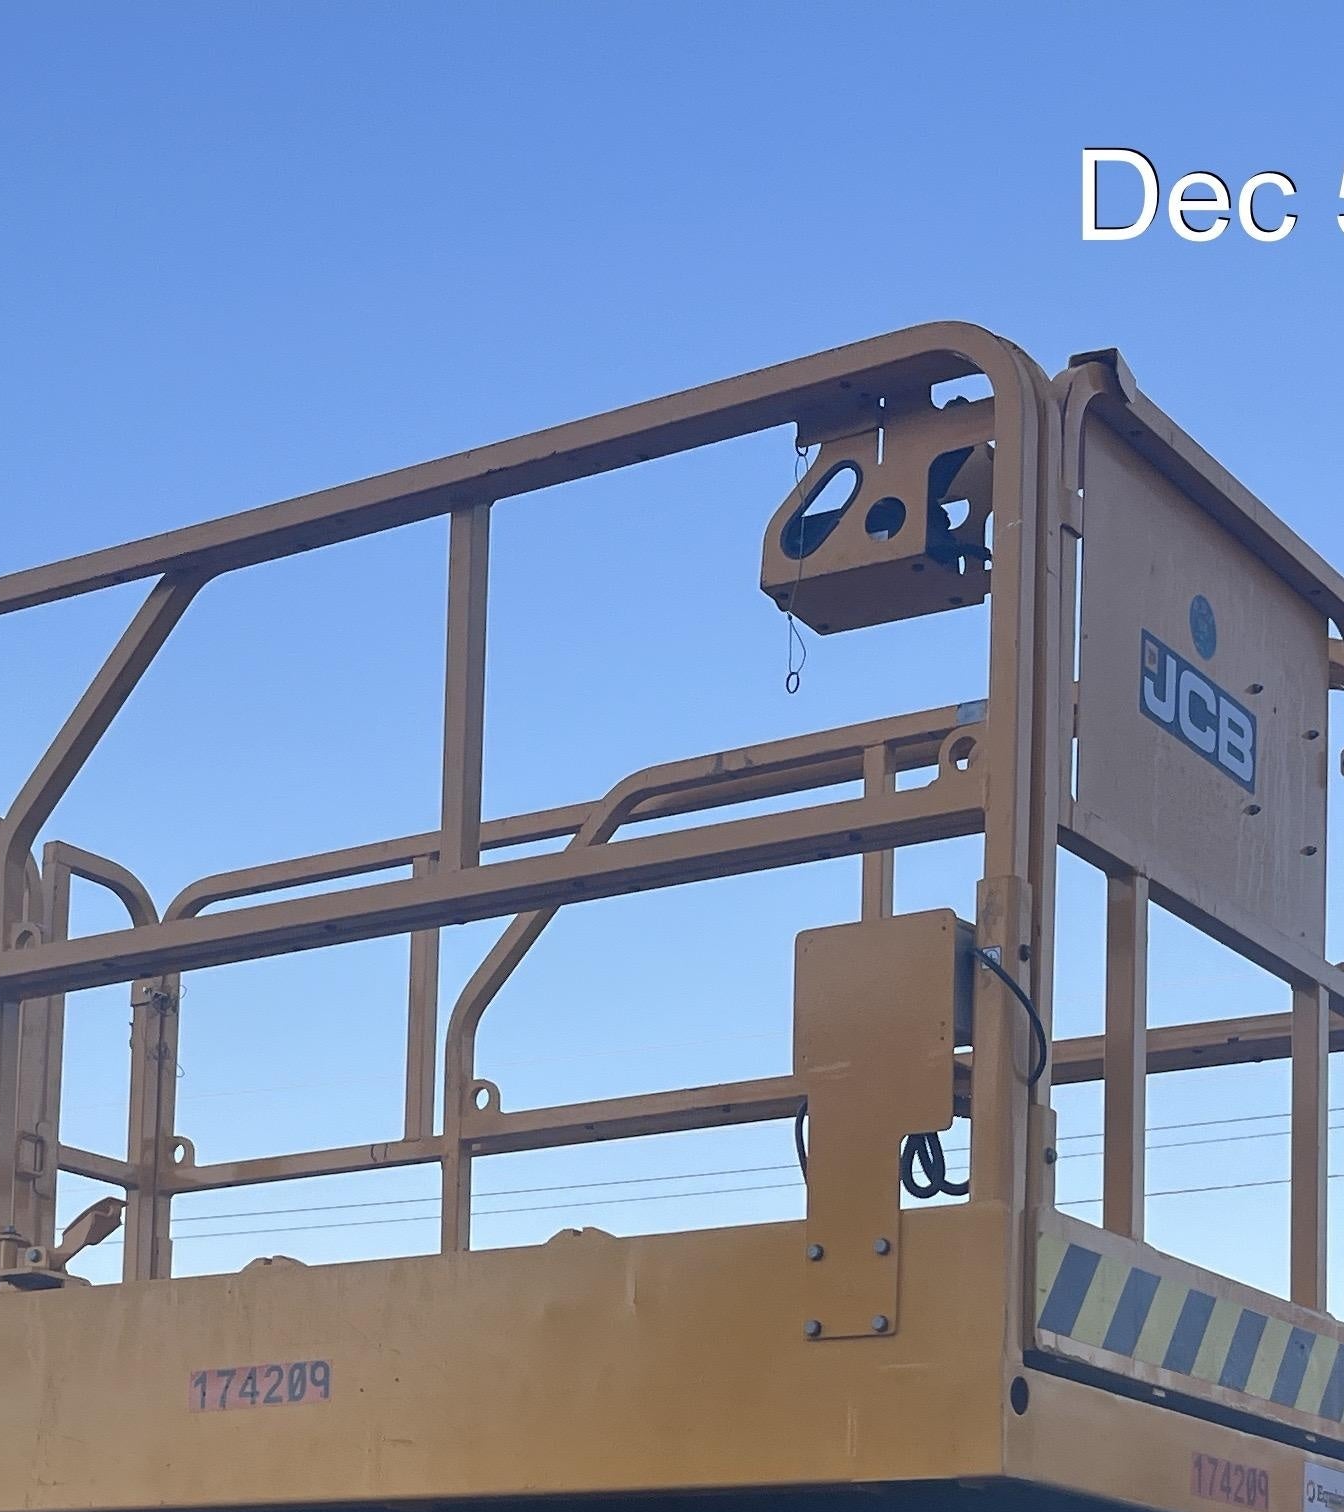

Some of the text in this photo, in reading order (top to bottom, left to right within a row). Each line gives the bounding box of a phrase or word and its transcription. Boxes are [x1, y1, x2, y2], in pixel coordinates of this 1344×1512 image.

[1144, 654, 1254, 782] JCB
[193, 1360, 330, 1409] 174209
[1193, 1454, 1269, 1512] 174209
